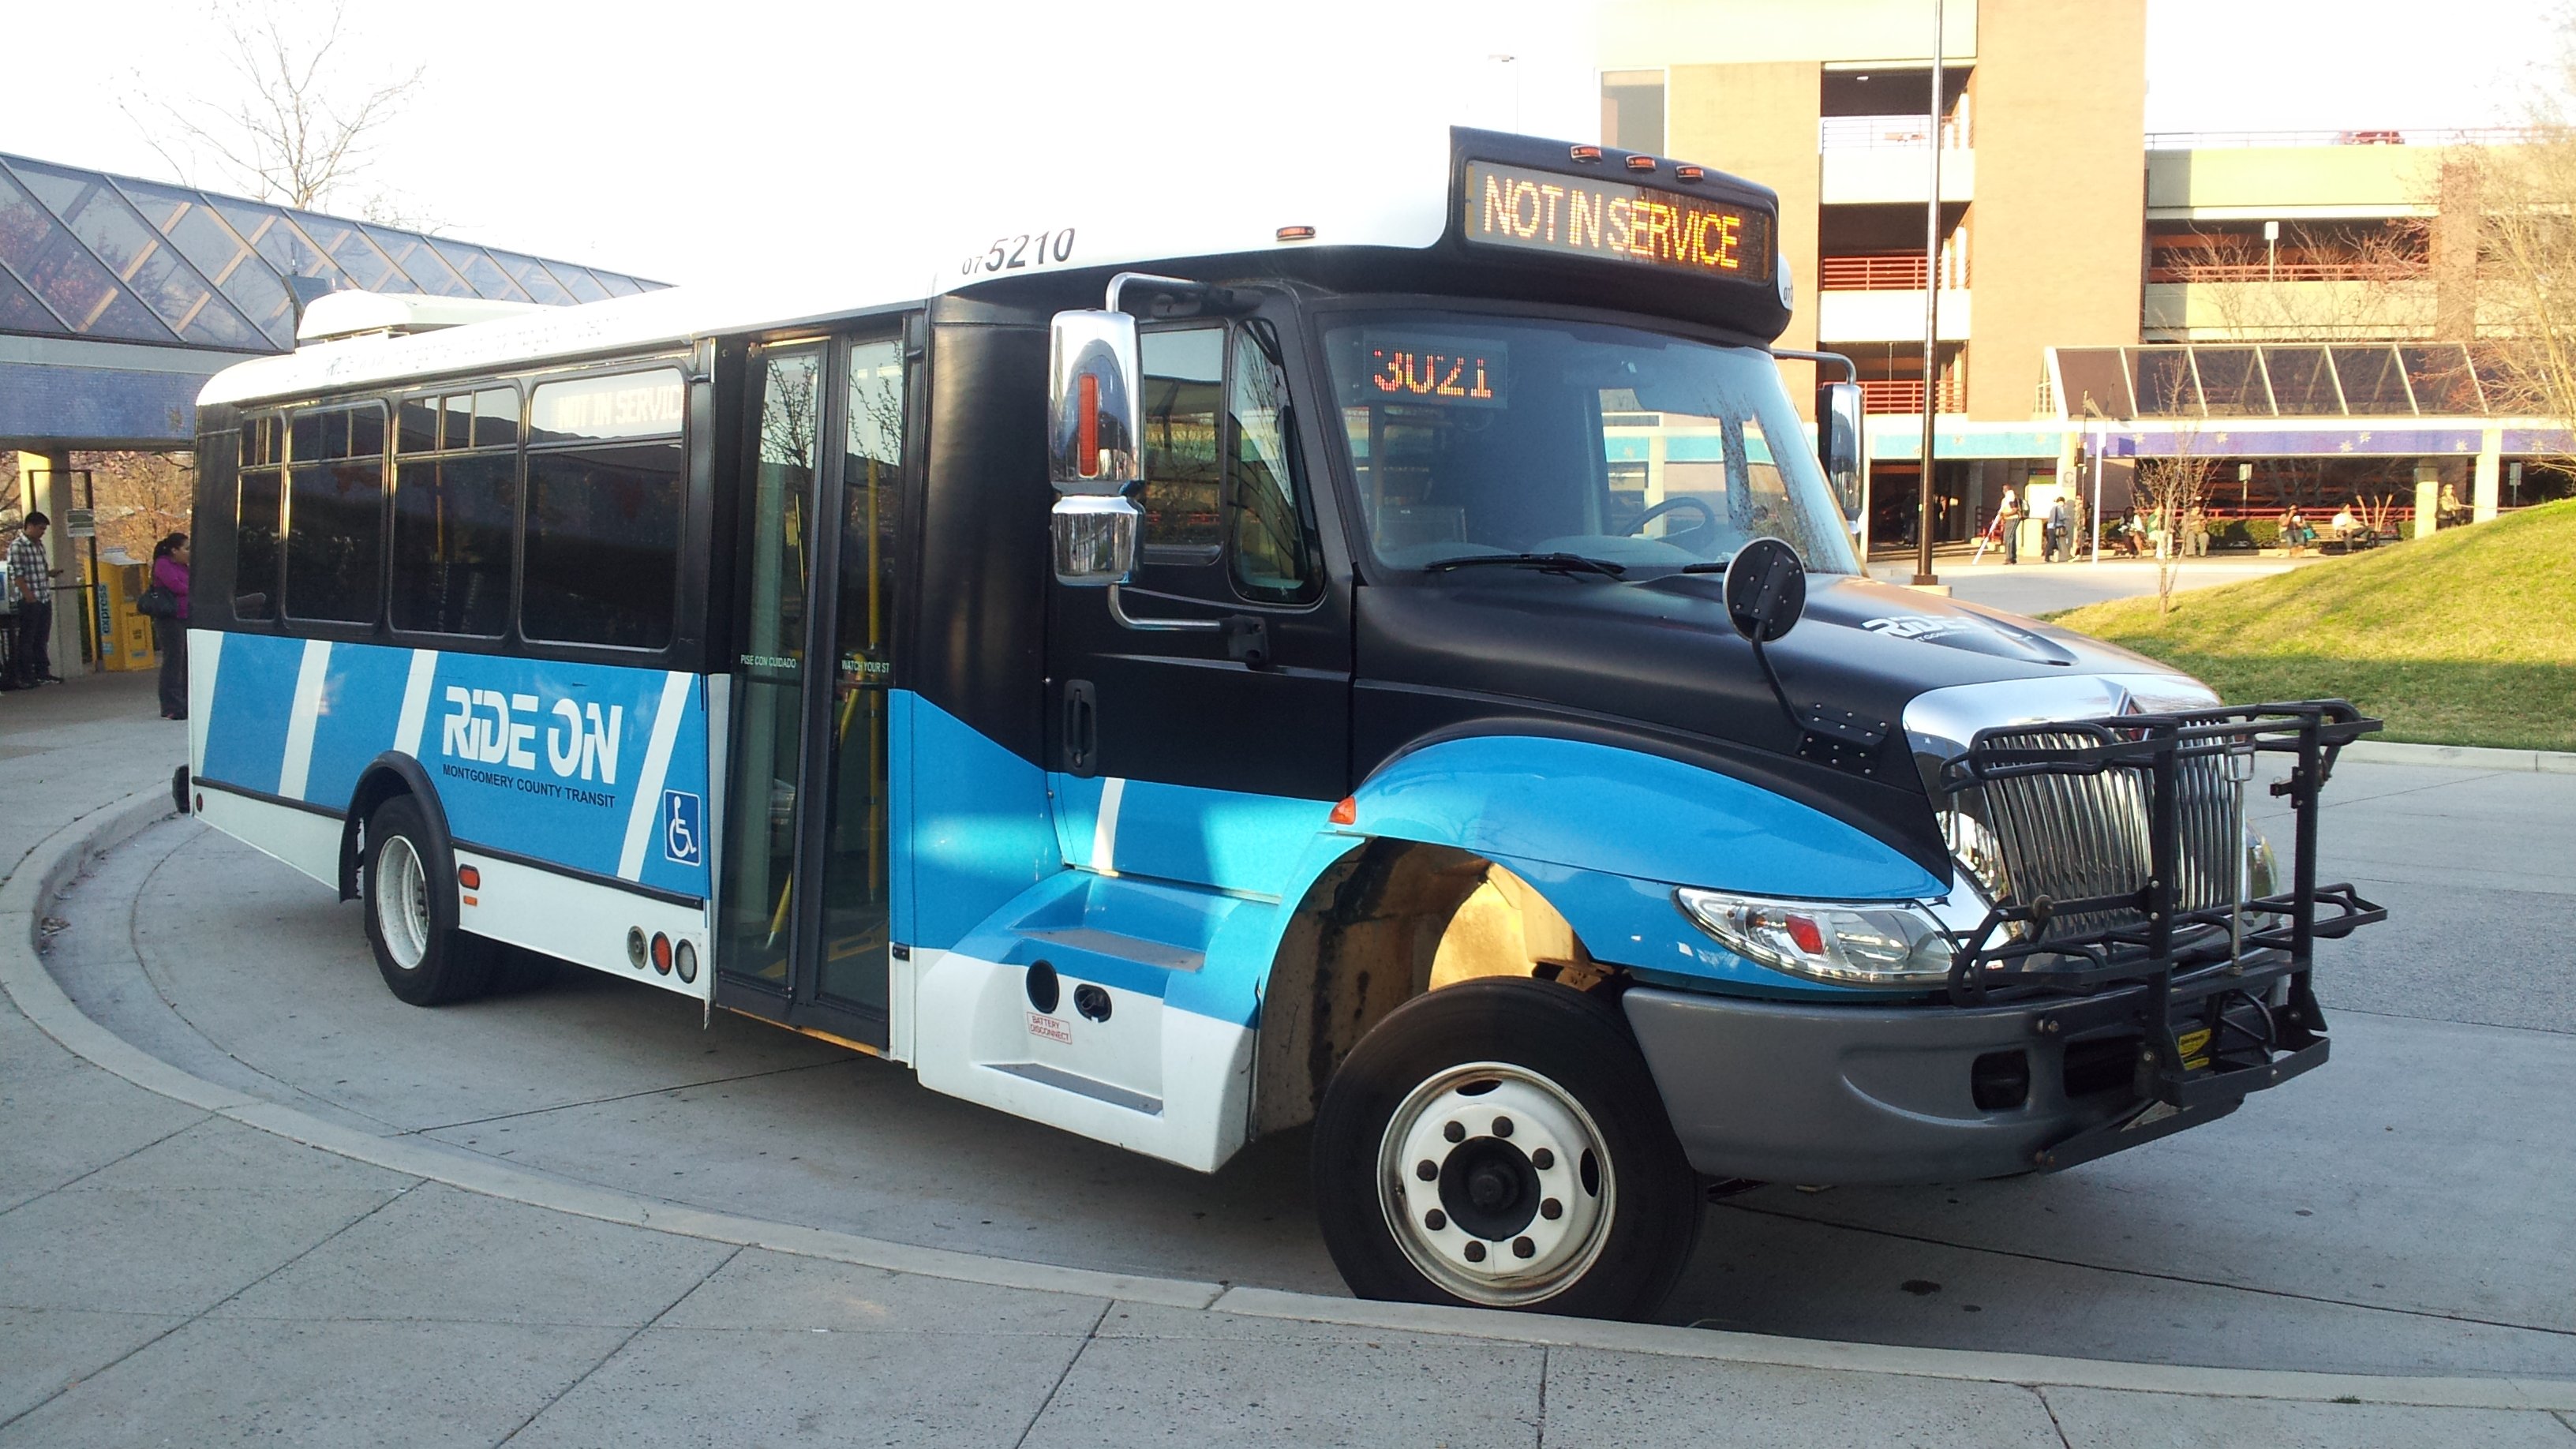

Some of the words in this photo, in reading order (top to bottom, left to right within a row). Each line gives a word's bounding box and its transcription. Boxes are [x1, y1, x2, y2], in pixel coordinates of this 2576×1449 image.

[1485, 174, 1563, 242] NOT
[1569, 190, 1602, 249] IN
[1608, 197, 1741, 269] SERVICE
[754, 656, 768, 666] CON
[841, 660, 863, 672] WATCH
[863, 661, 881, 672] YOUR
[547, 698, 623, 784] ON
[442, 763, 514, 789] MONTGOMERY
[516, 777, 562, 799] COUNTY
[564, 787, 616, 808] TRANSIT
[1032, 1015, 1060, 1029] BATTERY
